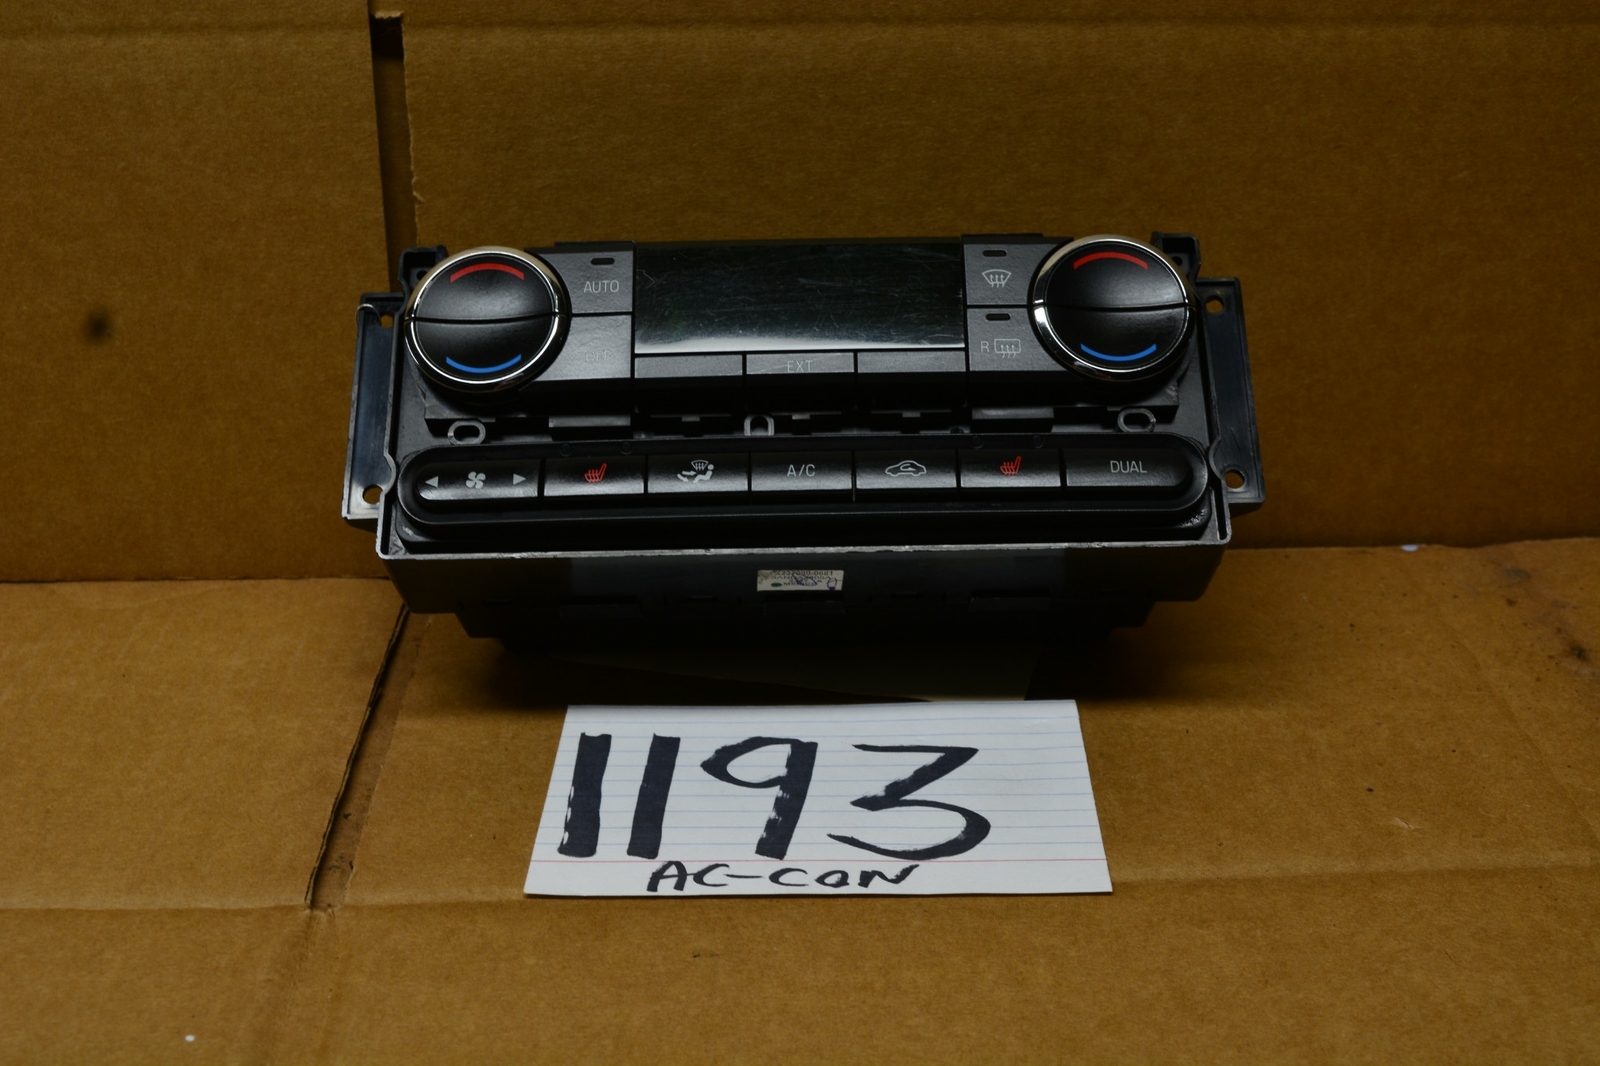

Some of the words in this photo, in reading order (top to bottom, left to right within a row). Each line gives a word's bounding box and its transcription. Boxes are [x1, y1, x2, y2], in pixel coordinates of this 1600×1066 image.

[583, 279, 620, 294] AUTO
[980, 340, 990, 353] R
[787, 359, 813, 373] EXT
[786, 463, 816, 477] A/C
[1109, 459, 1148, 474] DUAL
[558, 731, 991, 860] 1193
